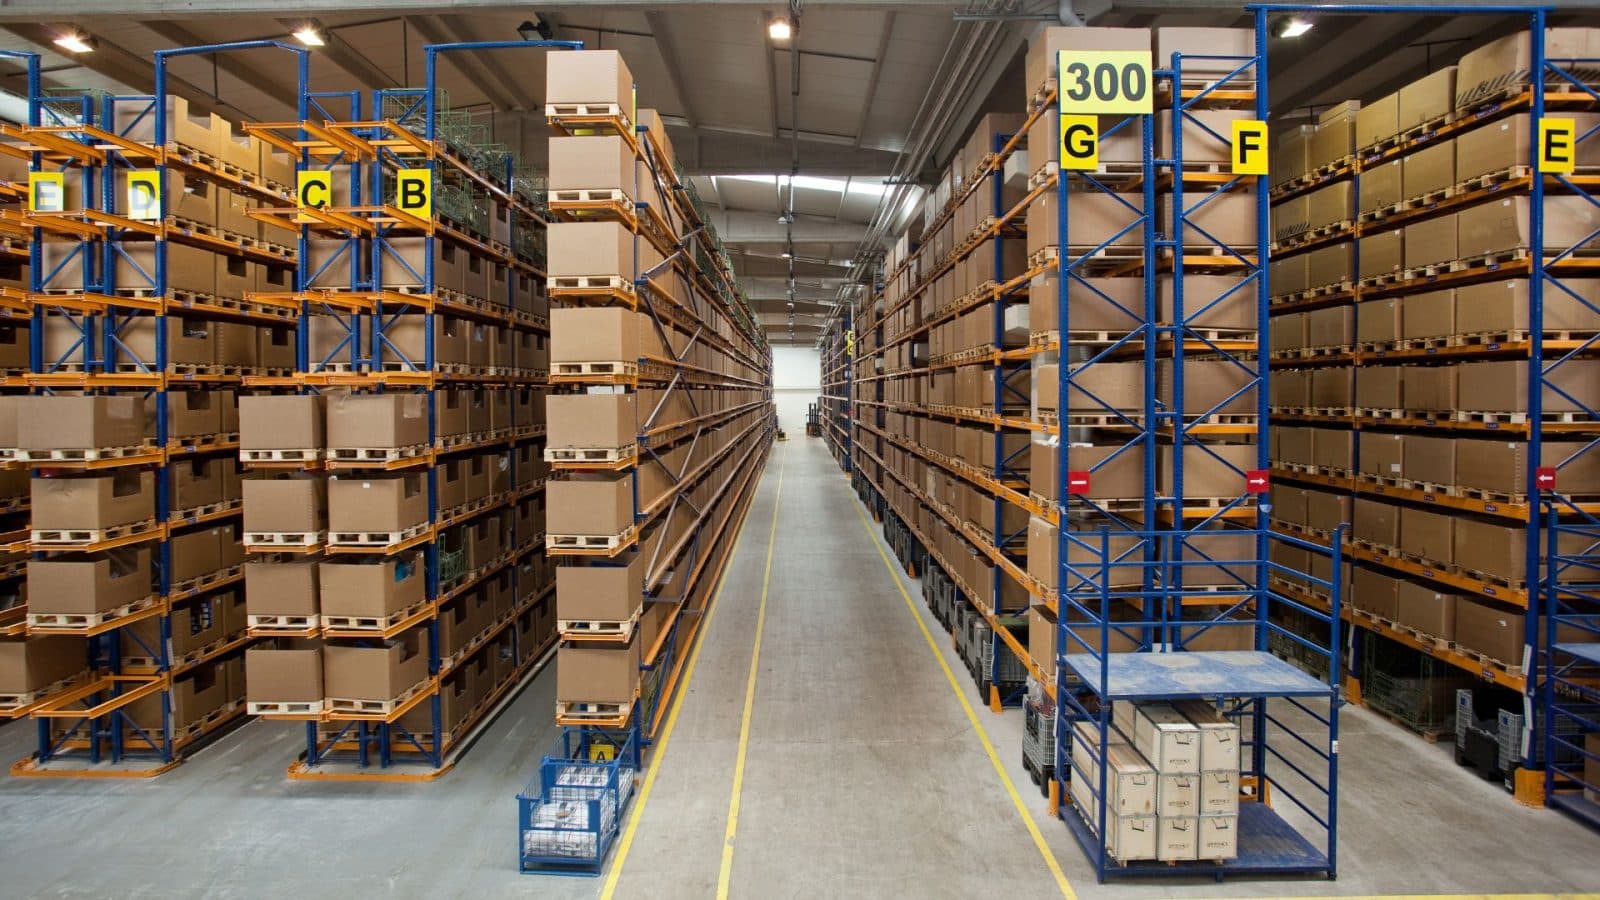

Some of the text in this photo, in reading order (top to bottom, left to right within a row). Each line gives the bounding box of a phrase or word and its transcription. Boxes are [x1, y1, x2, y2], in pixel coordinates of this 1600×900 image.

[1066, 62, 1146, 102] 300
[1064, 124, 1095, 158] G
[1239, 131, 1261, 163] F
[1545, 129, 1568, 162] E
[35, 181, 57, 210] E
[131, 181, 155, 210] D
[302, 180, 327, 209] C
[402, 179, 426, 208] B
